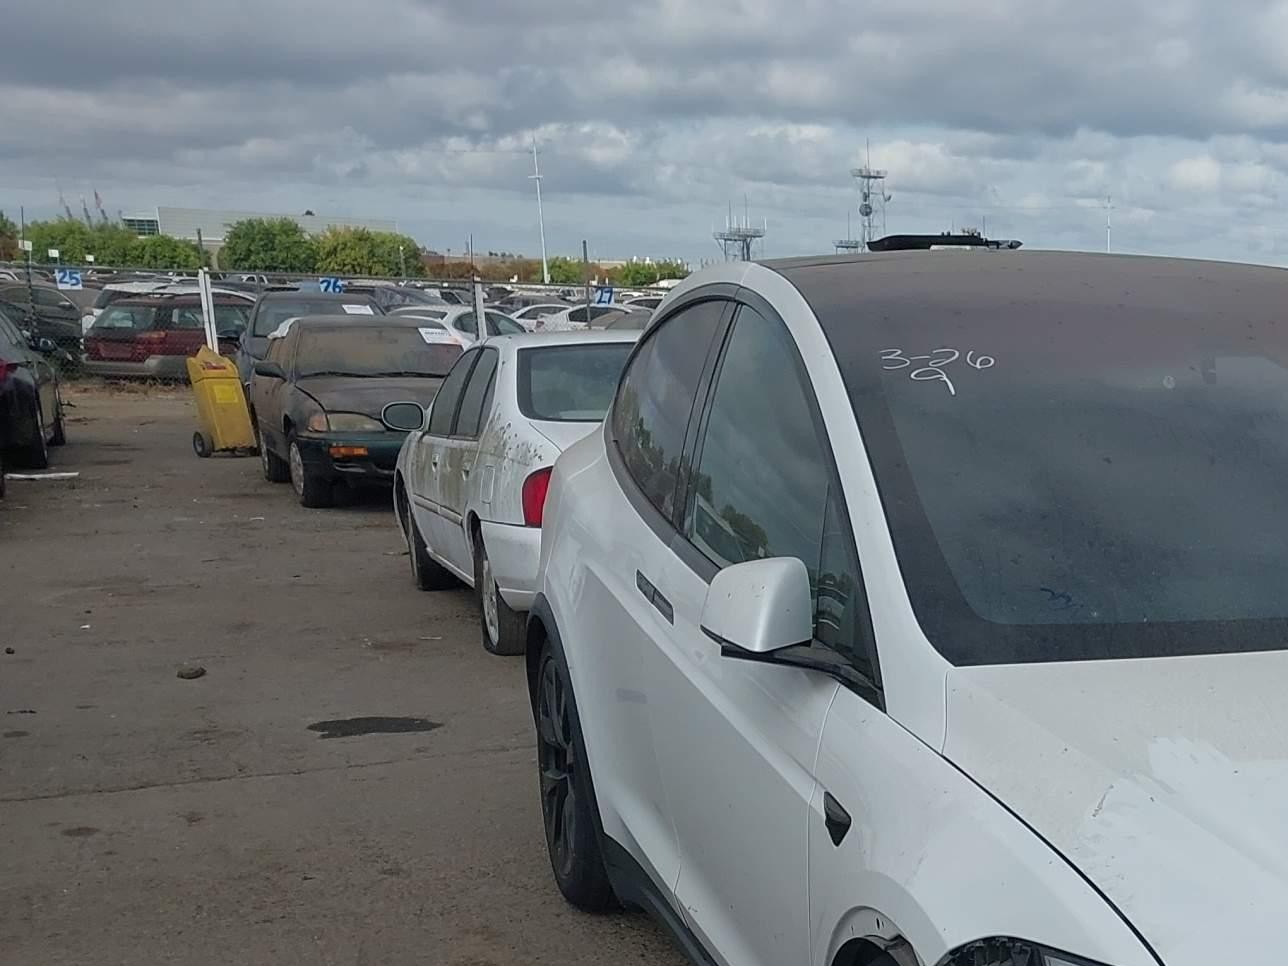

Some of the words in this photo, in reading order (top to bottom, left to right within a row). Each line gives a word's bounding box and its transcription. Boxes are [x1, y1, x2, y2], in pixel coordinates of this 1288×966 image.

[58, 270, 81, 287] 25
[596, 287, 614, 305] 27
[879, 348, 995, 370] 3-26
